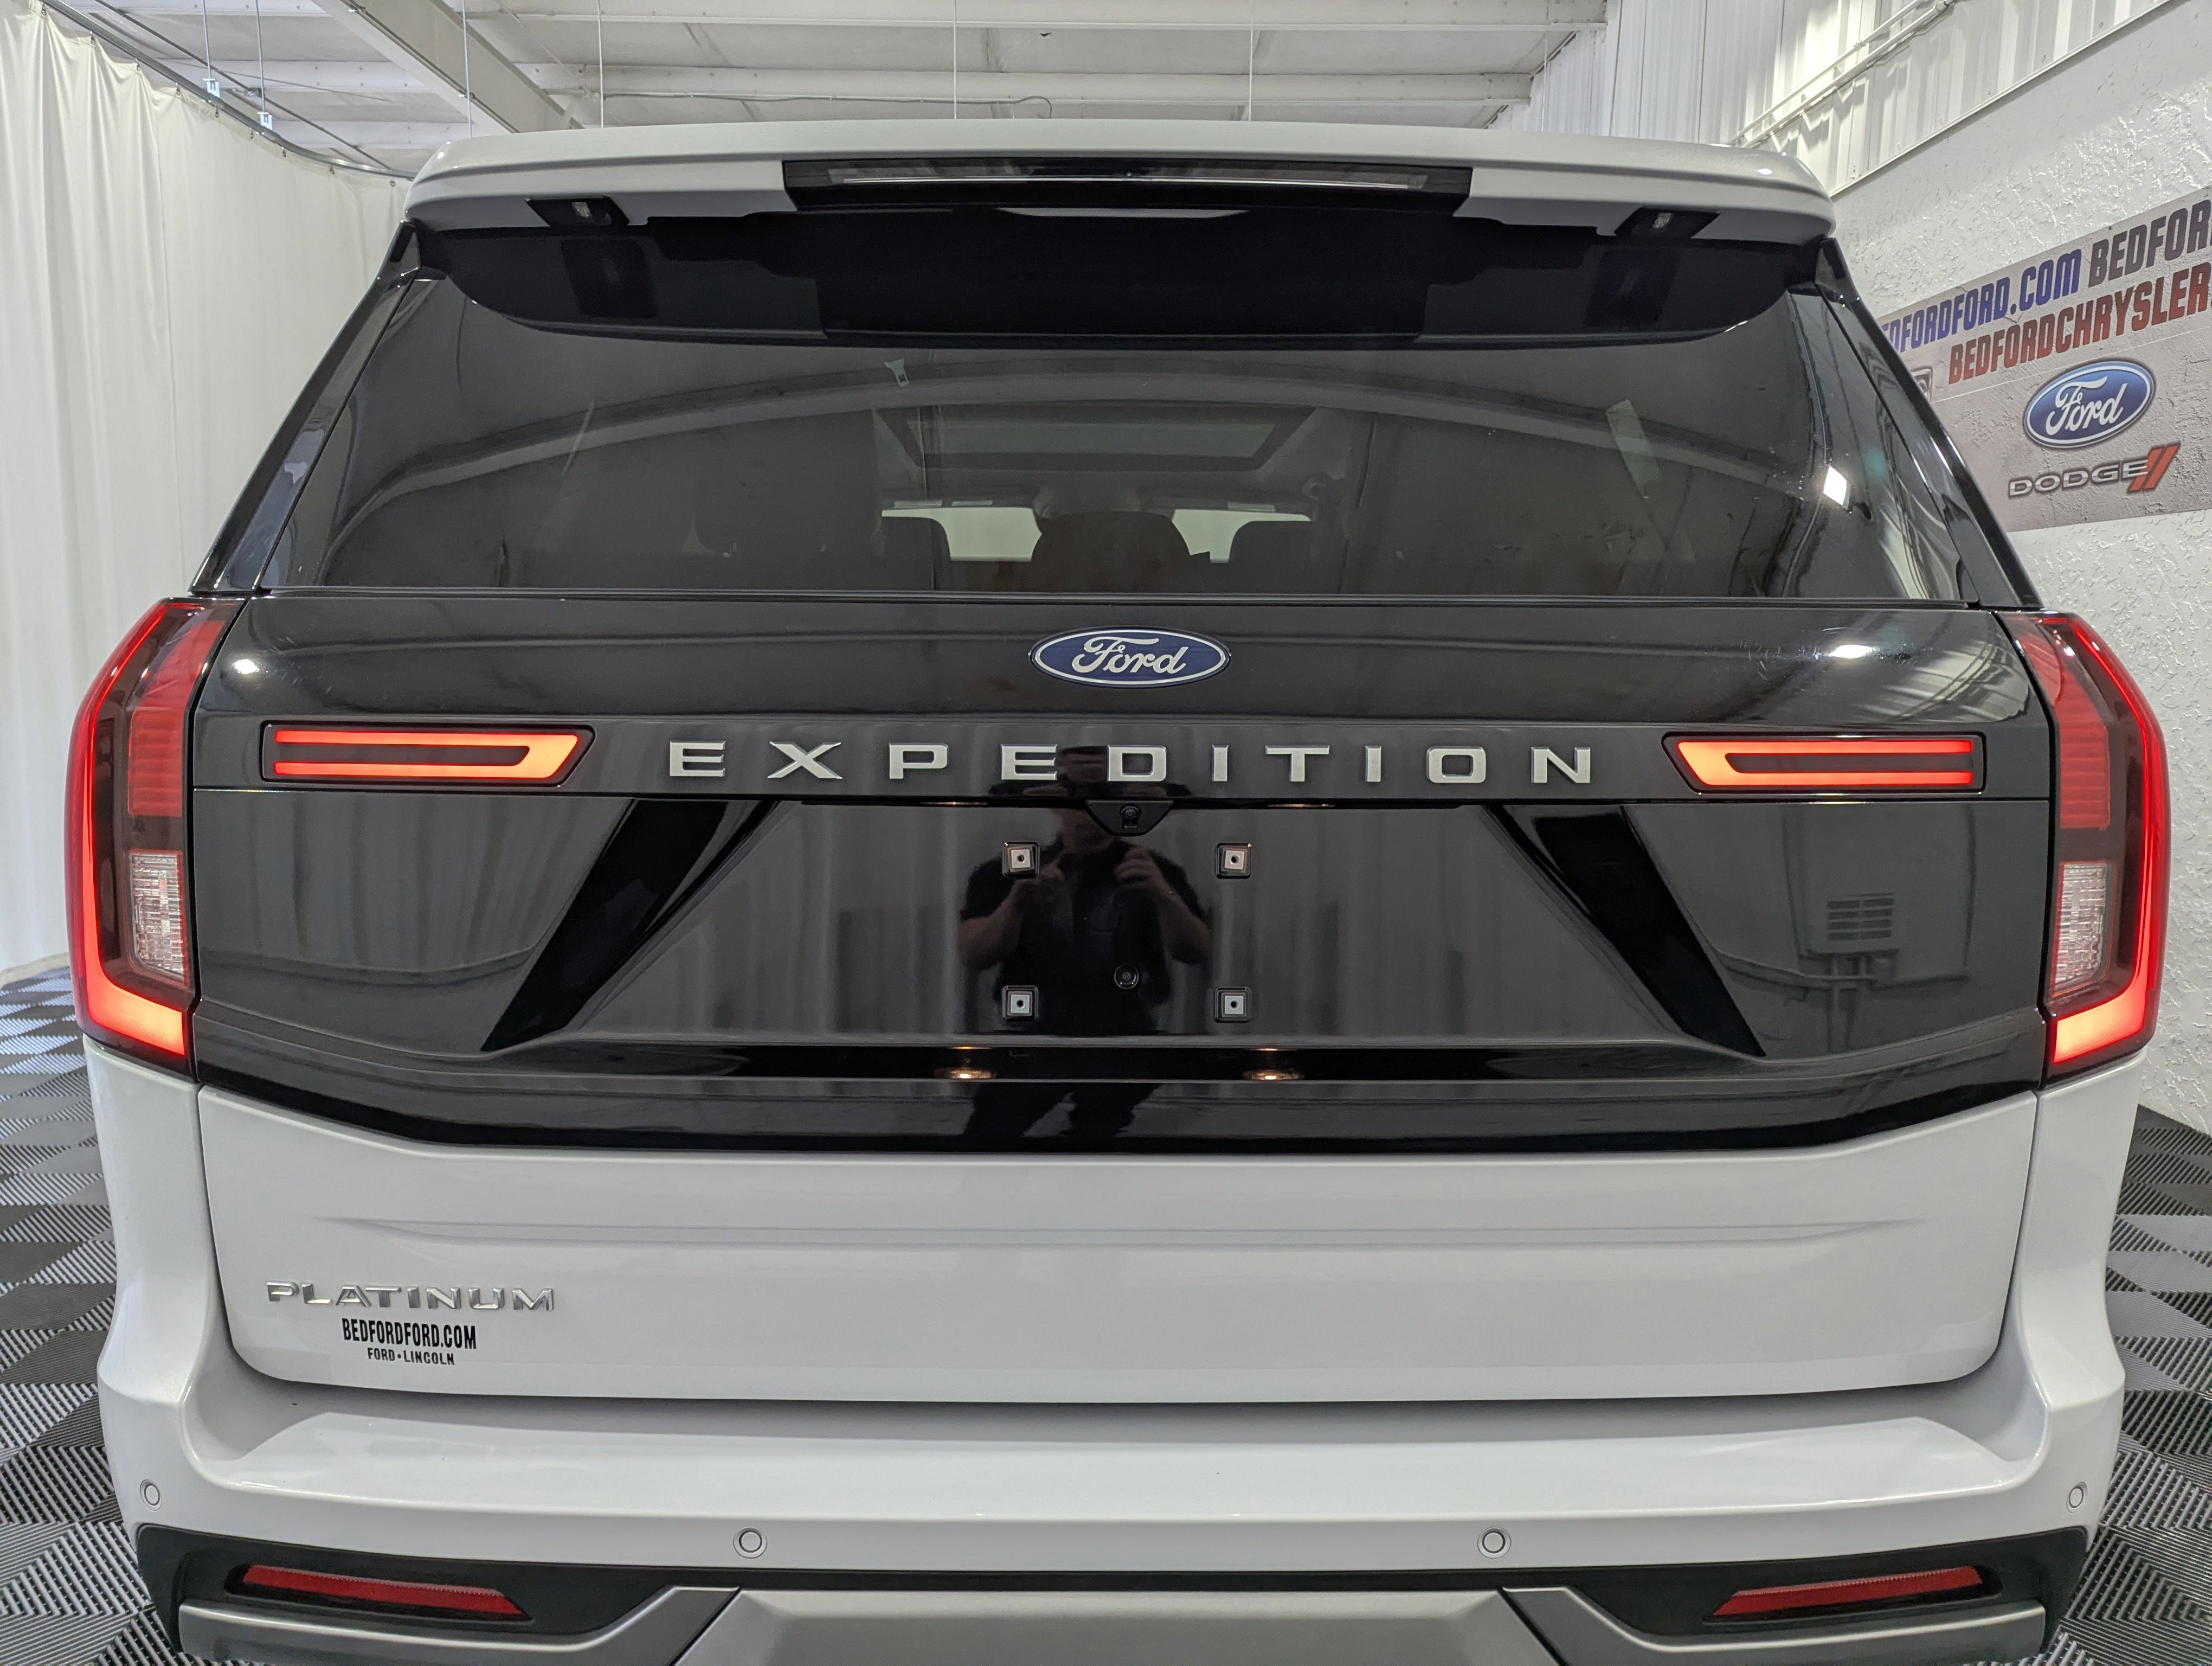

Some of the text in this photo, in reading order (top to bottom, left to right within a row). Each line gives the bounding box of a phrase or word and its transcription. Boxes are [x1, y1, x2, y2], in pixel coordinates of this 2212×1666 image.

[1881, 199, 2212, 354] DFORDFORD.COM BEDFOR
[2045, 375, 2127, 436] Ford
[2008, 458, 2149, 497] DODGE
[1071, 636, 1189, 674] Ford
[669, 740, 1591, 784] EXPEDITION
[266, 1280, 555, 1311] PLATINUM
[342, 1318, 477, 1350] BEDFORDFORD.COM
